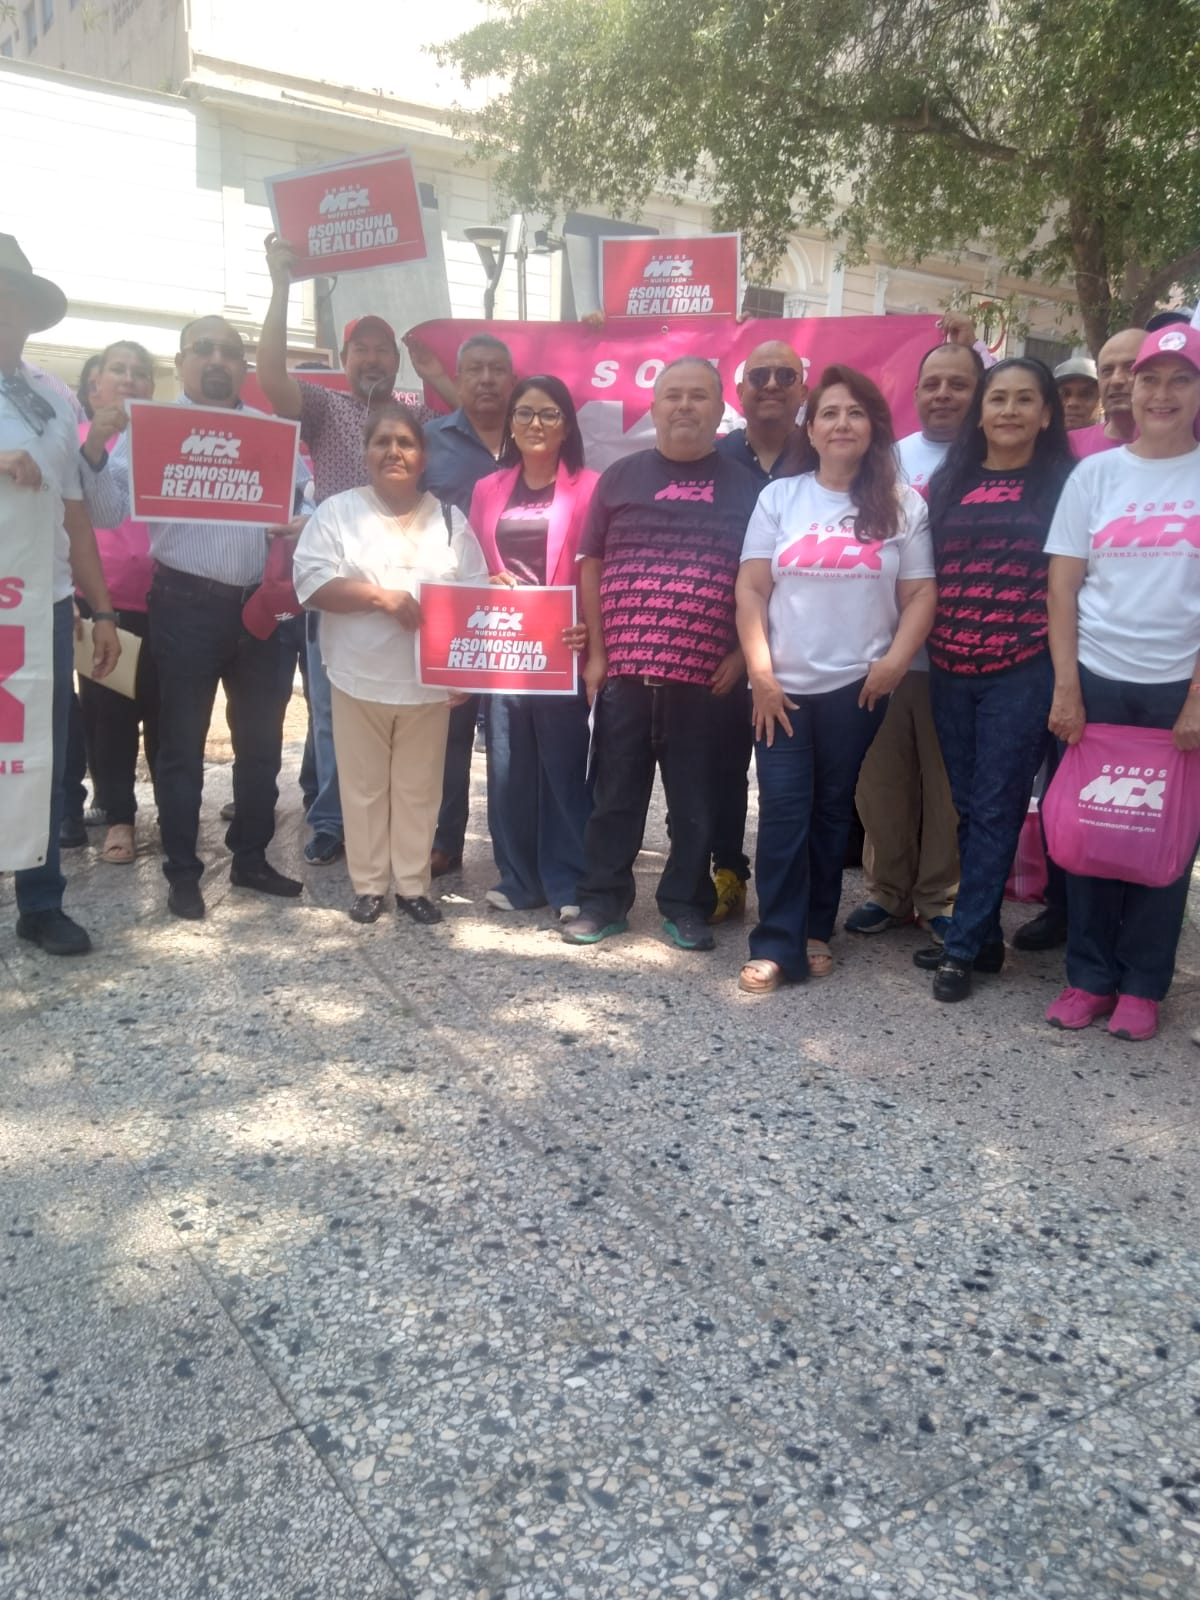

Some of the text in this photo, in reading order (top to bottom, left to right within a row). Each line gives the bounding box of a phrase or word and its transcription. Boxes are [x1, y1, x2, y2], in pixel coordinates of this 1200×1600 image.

[308, 213, 393, 239] #SOMOSUNA
[309, 226, 399, 257] REALIDAD
[643, 260, 694, 277] MX
[628, 285, 711, 300] #SOMOSUNA
[626, 298, 714, 315] REALIDAD
[180, 434, 242, 459] MX
[163, 464, 260, 484] #SOMOSUNA
[161, 479, 264, 502] REALIDAD
[466, 611, 523, 631] MX
[450, 638, 543, 654] #SOMOSUNA
[447, 651, 548, 671] REALIDAD
[1102, 764, 1167, 778] SOMOS
[1079, 775, 1166, 810] MX
